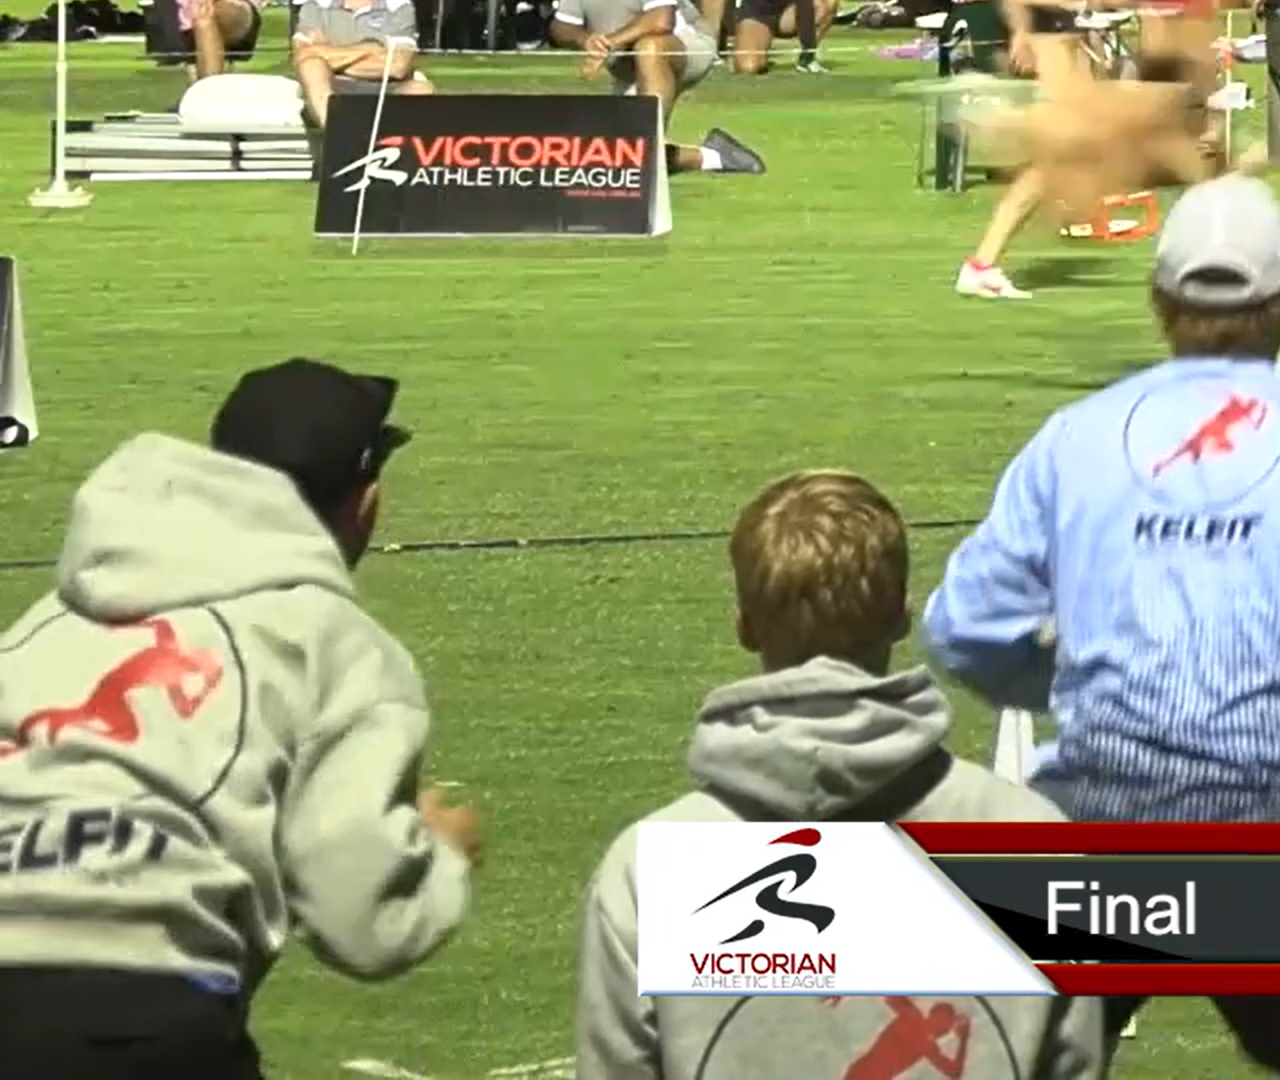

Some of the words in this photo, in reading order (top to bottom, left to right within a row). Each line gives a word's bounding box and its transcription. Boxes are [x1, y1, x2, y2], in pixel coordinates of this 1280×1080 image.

[411, 136, 645, 167] VICTORIAN
[410, 166, 533, 187] ATHLETIC
[540, 167, 641, 188] LEAGUE
[1134, 512, 1265, 546] KELFIT
